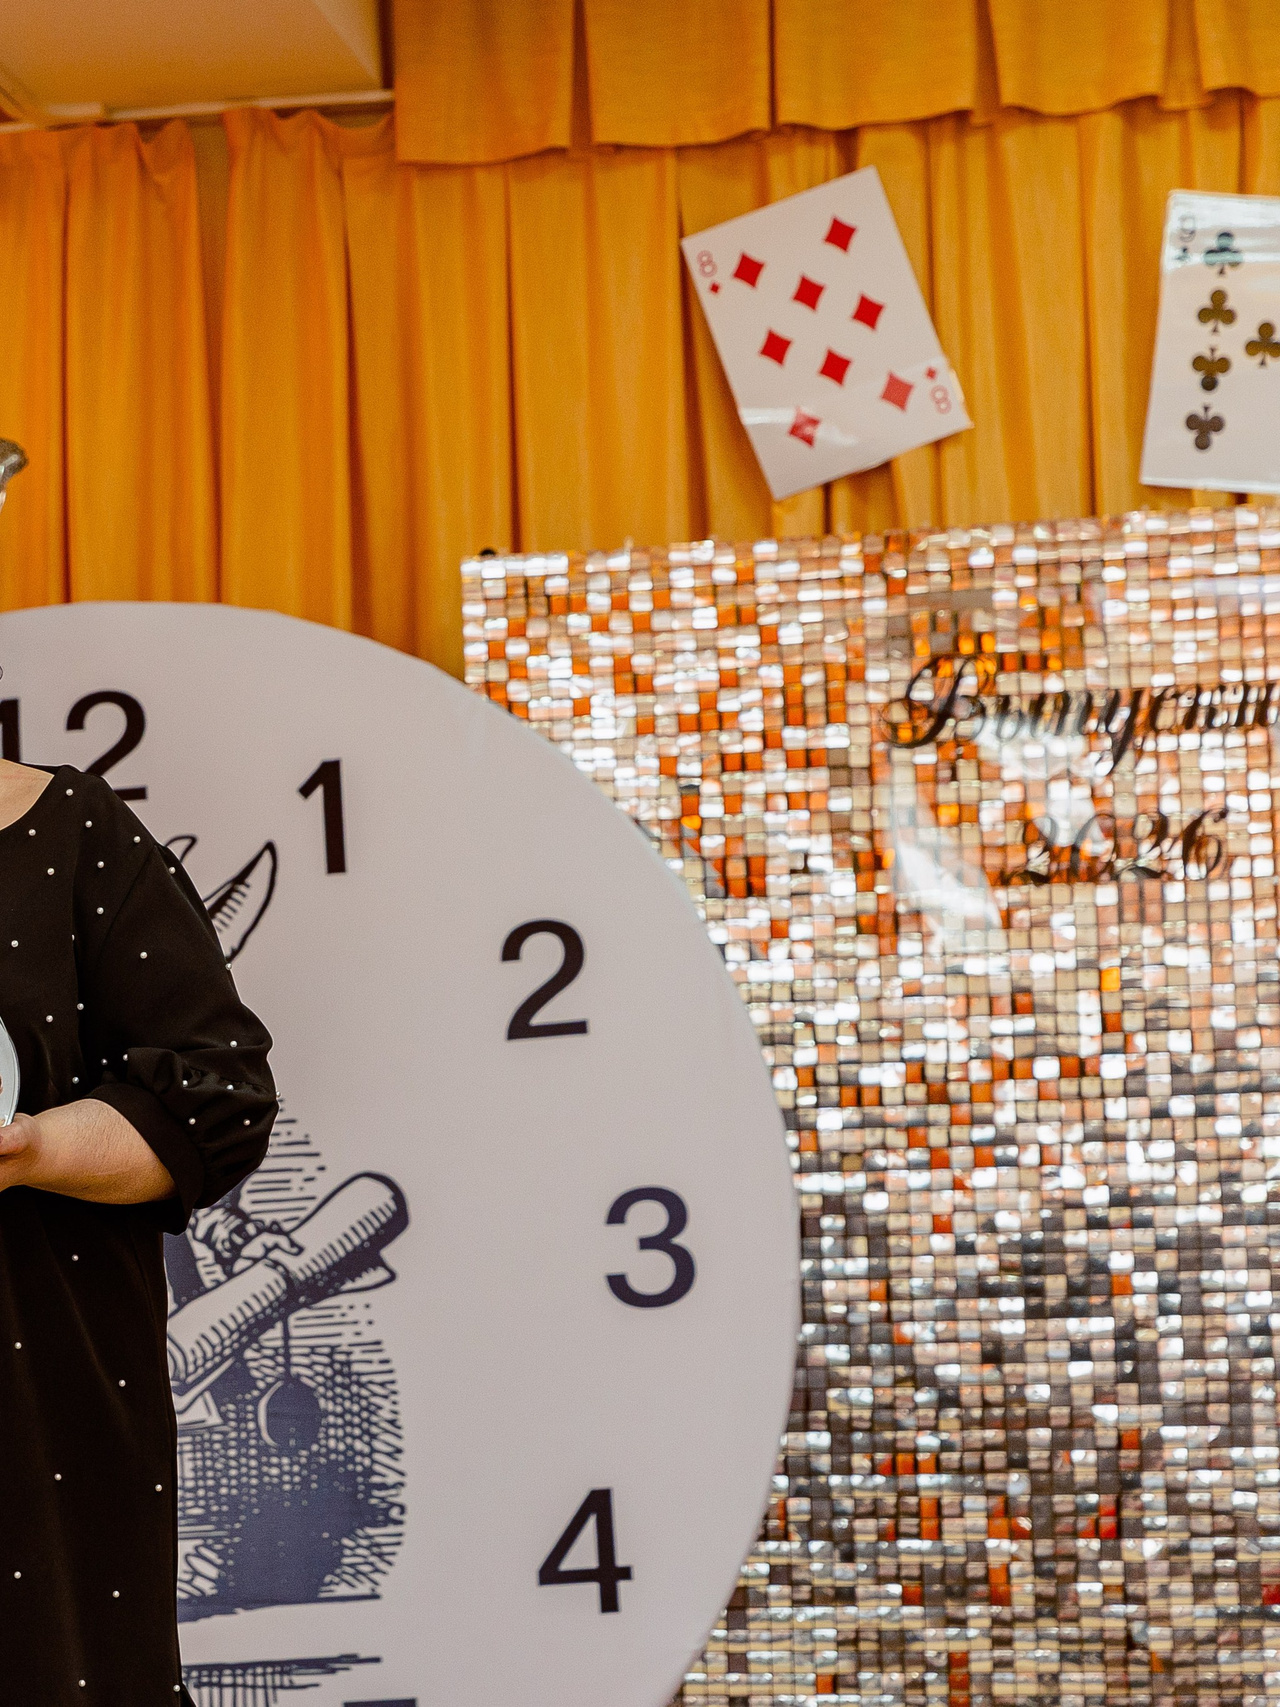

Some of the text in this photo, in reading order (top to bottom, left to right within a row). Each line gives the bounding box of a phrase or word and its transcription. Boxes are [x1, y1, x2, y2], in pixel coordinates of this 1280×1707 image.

[696, 250, 718, 279] 8
[929, 385, 951, 414] 8
[297, 759, 347, 875] 1
[501, 920, 588, 1041] 2
[606, 1187, 695, 1308] 3
[538, 1488, 633, 1613] 4
